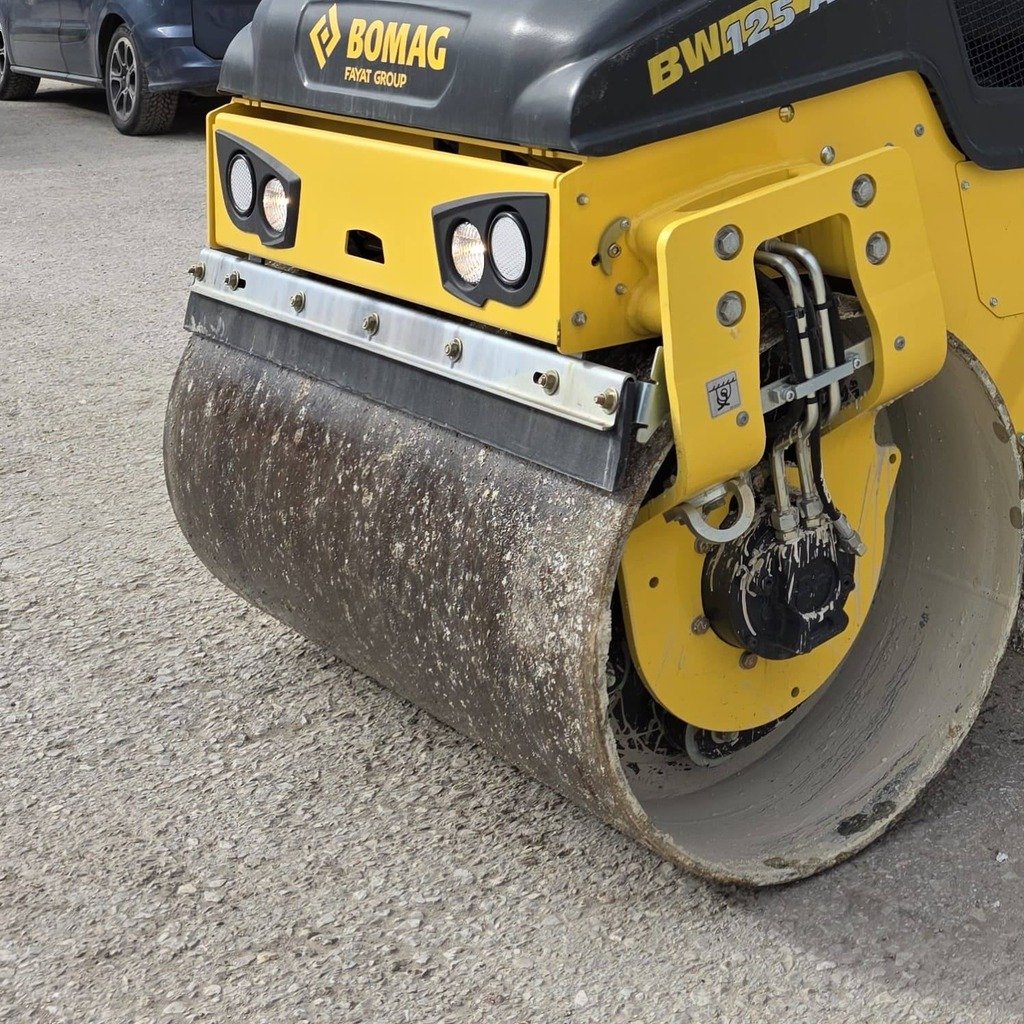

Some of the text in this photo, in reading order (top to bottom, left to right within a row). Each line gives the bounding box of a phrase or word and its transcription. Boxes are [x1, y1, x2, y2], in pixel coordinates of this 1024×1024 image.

[346, 18, 451, 71] BOMAG
[647, 22, 723, 96] BW
[344, 66, 408, 89] FAYAT GROUP
